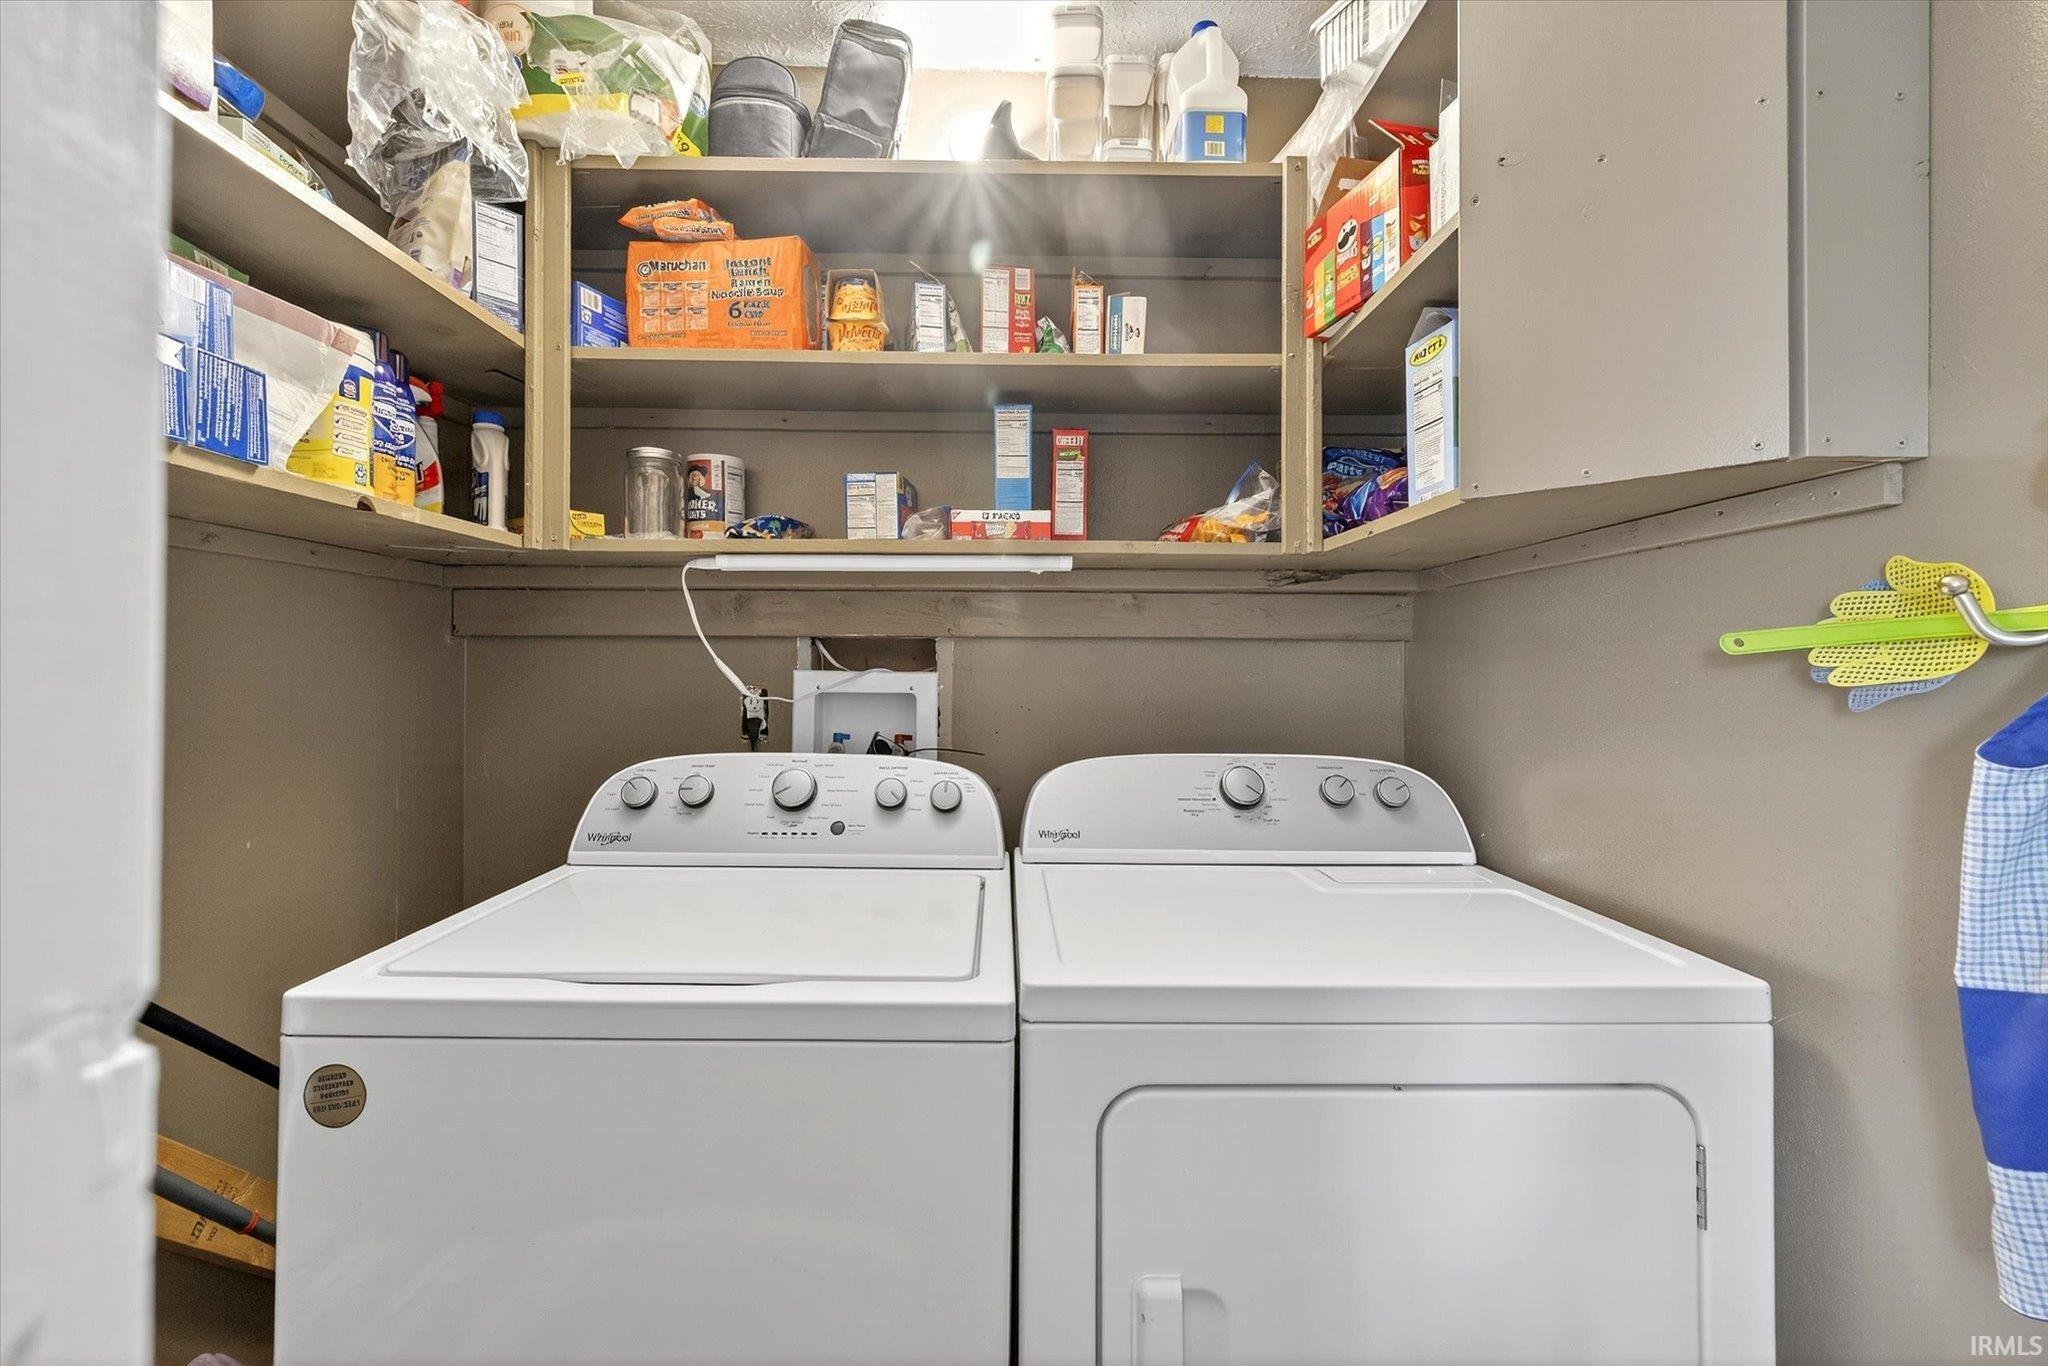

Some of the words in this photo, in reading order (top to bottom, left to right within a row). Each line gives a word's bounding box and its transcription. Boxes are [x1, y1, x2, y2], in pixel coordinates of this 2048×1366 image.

[728, 301, 742, 319] 6
[587, 831, 632, 846] Whirlpool
[1038, 829, 1081, 843] Whirlpool
